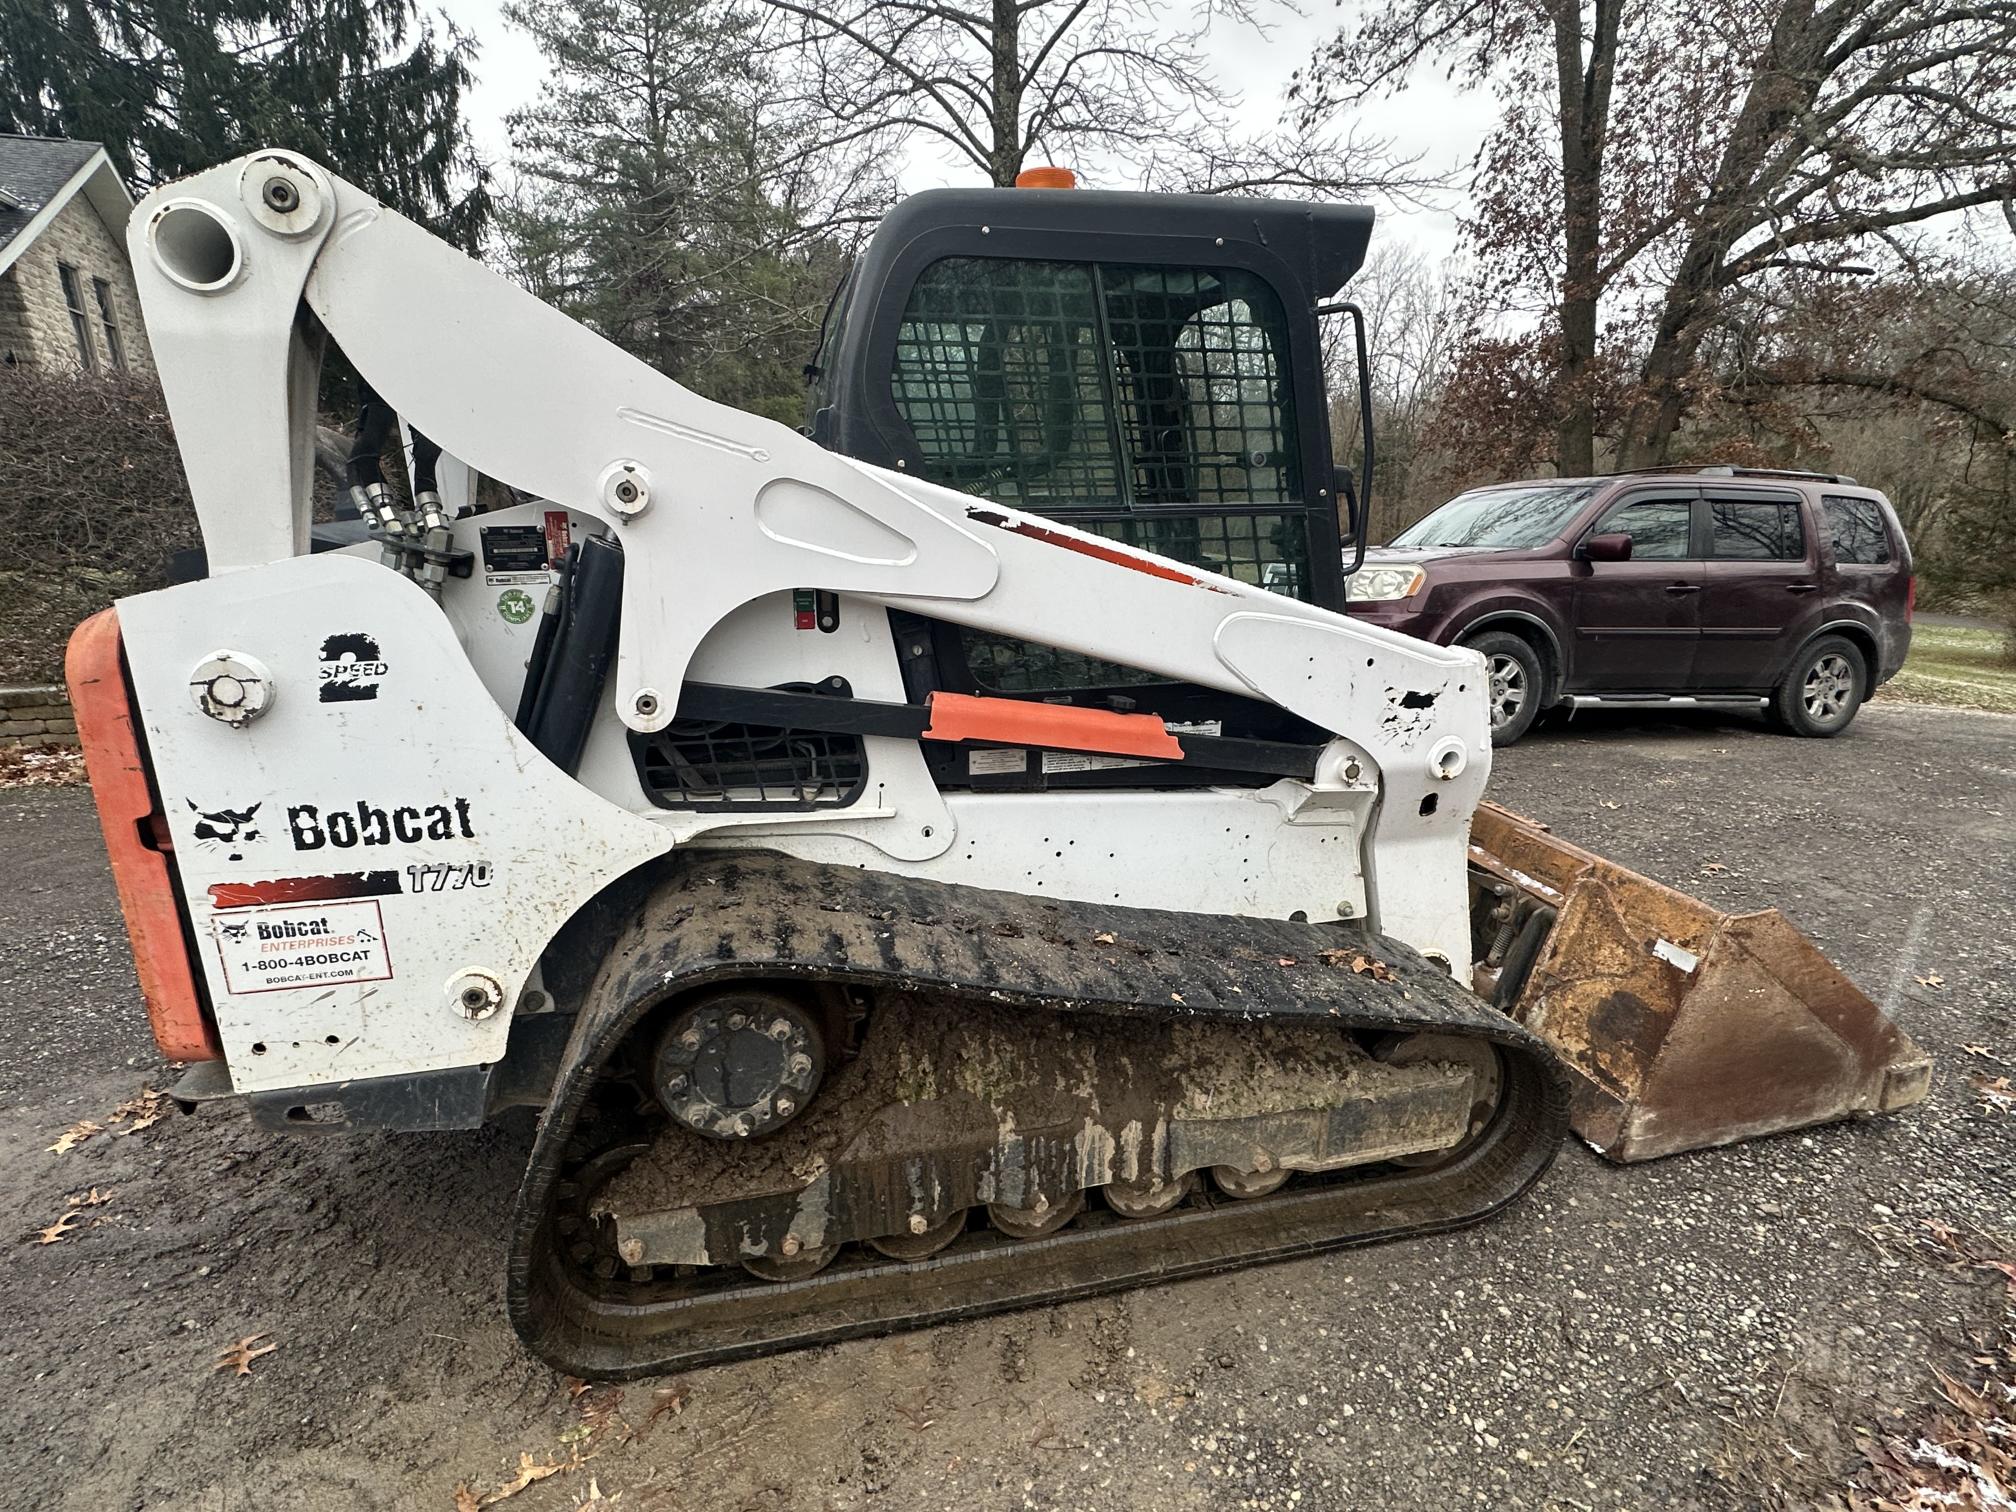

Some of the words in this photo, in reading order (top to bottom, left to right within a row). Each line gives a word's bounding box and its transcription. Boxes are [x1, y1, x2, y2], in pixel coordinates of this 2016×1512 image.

[507, 600, 526, 614] T4
[318, 662, 389, 679] SPEED
[287, 797, 475, 851] Bobcat
[407, 860, 494, 893] T770
[256, 917, 331, 941] Bobcat
[260, 934, 356, 953] ENTERPRISES
[242, 950, 371, 972] 1-800-4BOBCAT
